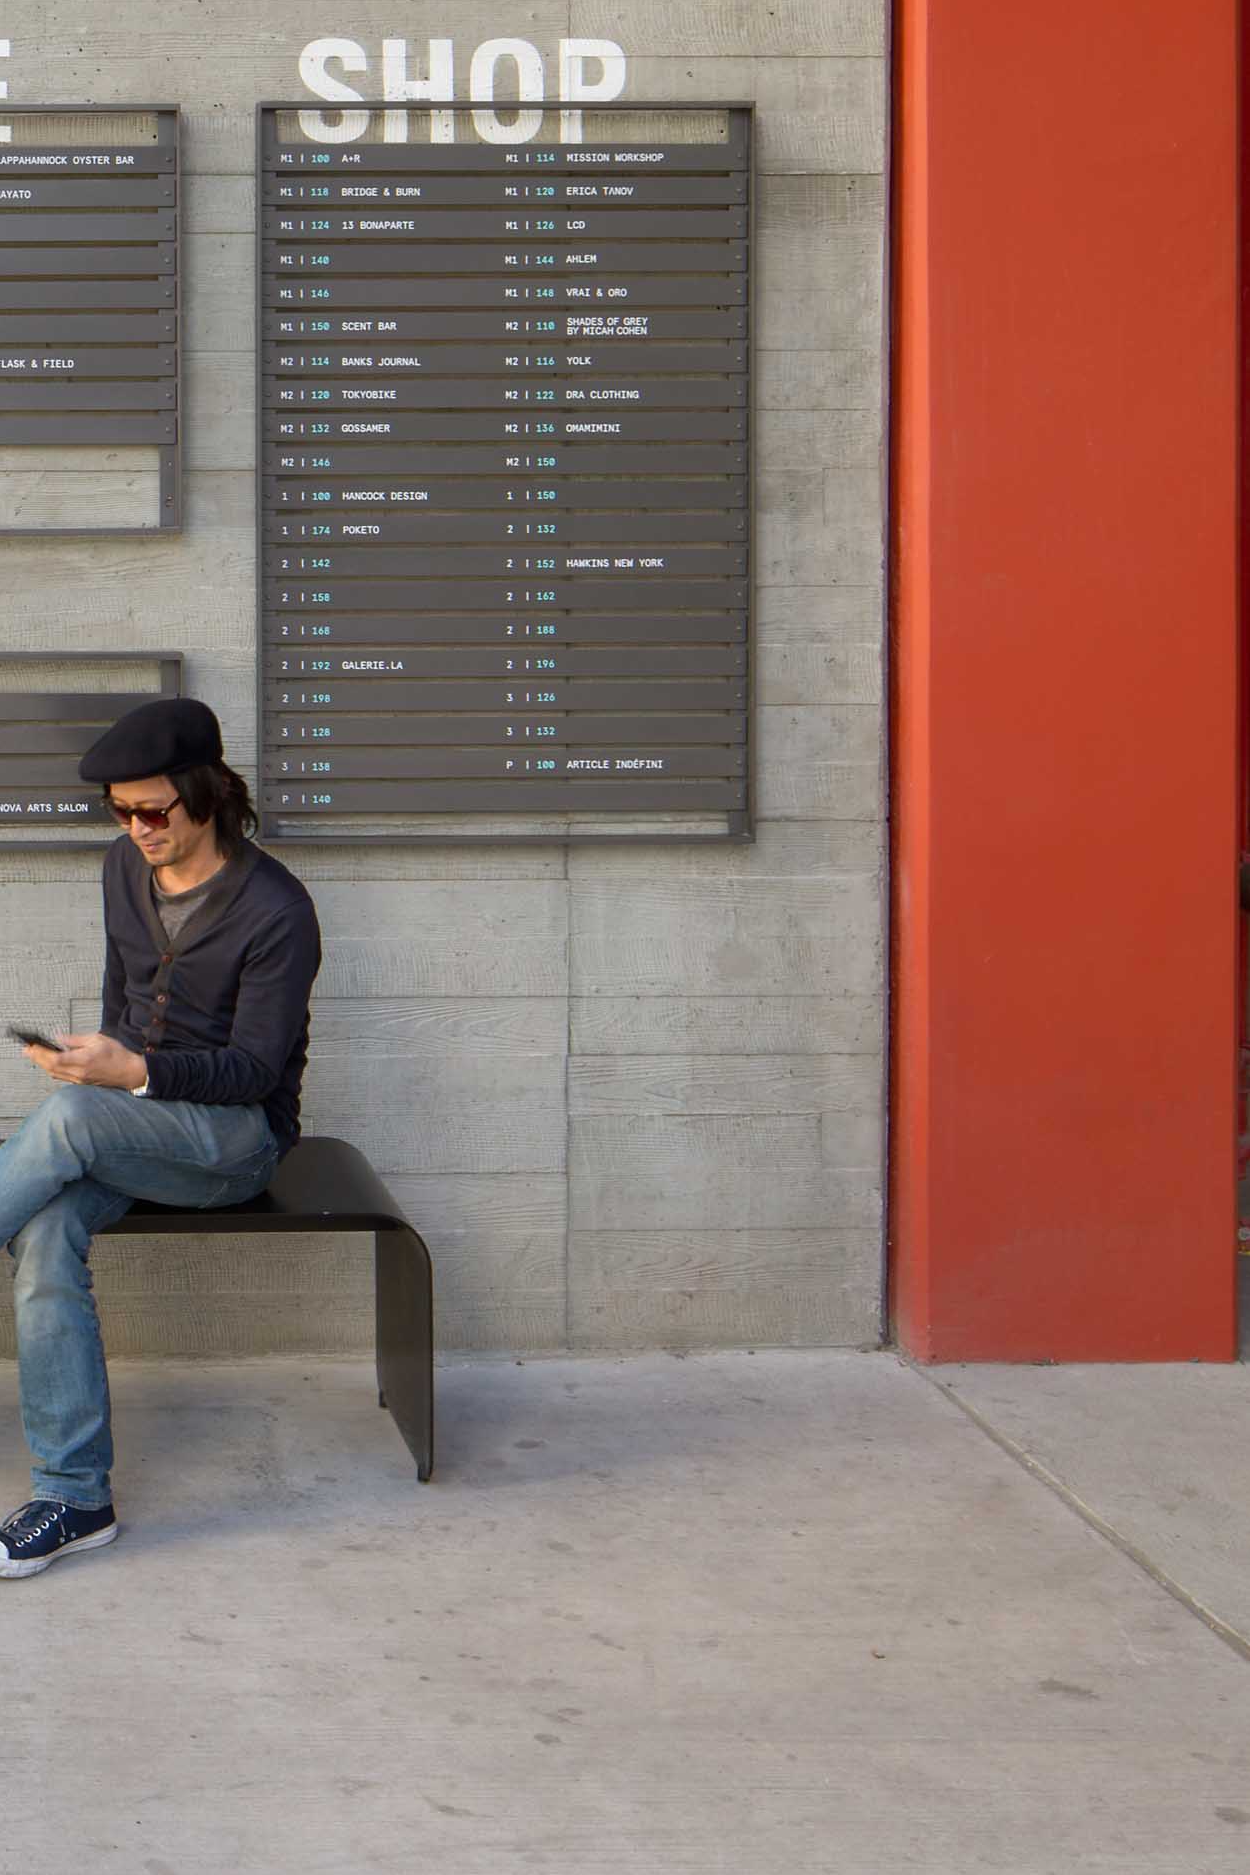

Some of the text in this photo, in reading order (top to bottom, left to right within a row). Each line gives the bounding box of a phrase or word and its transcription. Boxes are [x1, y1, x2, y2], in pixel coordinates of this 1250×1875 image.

[298, 38, 625, 144] SHOP
[73, 156, 110, 164] OYSTER
[116, 156, 134, 164] BAR
[281, 154, 293, 162] M1
[342, 154, 360, 162] A+R
[506, 153, 664, 162] M1 114 MISSION WORKSHOP
[342, 188, 420, 196] BRIDGE & BURN
[567, 187, 597, 195] ERICA
[312, 221, 329, 229] 124
[360, 221, 414, 229] BONAPARTE
[537, 221, 554, 229] 126
[567, 221, 585, 229] LCD
[566, 255, 597, 263] AHLEM
[566, 288, 627, 297] VRAI & ORO
[567, 317, 648, 326] SHADES OF GREY
[281, 322, 396, 331] M1 150 SCENT BAR
[567, 327, 647, 335] BY MICAH COHEN
[31, 360, 38, 368] &
[43, 360, 74, 368] FIELD
[342, 358, 421, 366] BANKS JOURNAL
[506, 357, 591, 365] M2 116 YOLK
[342, 390, 396, 399] TOKYOBIKE
[566, 391, 639, 399] DRA CLOTHING
[342, 424, 390, 432] GOSSAMER
[566, 424, 620, 432] OMAMIMINI
[343, 492, 385, 500] HANCOCK
[391, 492, 427, 500] DESIGN
[313, 526, 379, 534] 174 POKETO
[567, 559, 664, 567] HAWKINS NEW YORK
[312, 662, 330, 670] 192
[567, 760, 609, 769] ARTICLE
[313, 795, 331, 803] 140
[27, 804, 52, 812] ARTS
[57, 804, 88, 812] SALON
